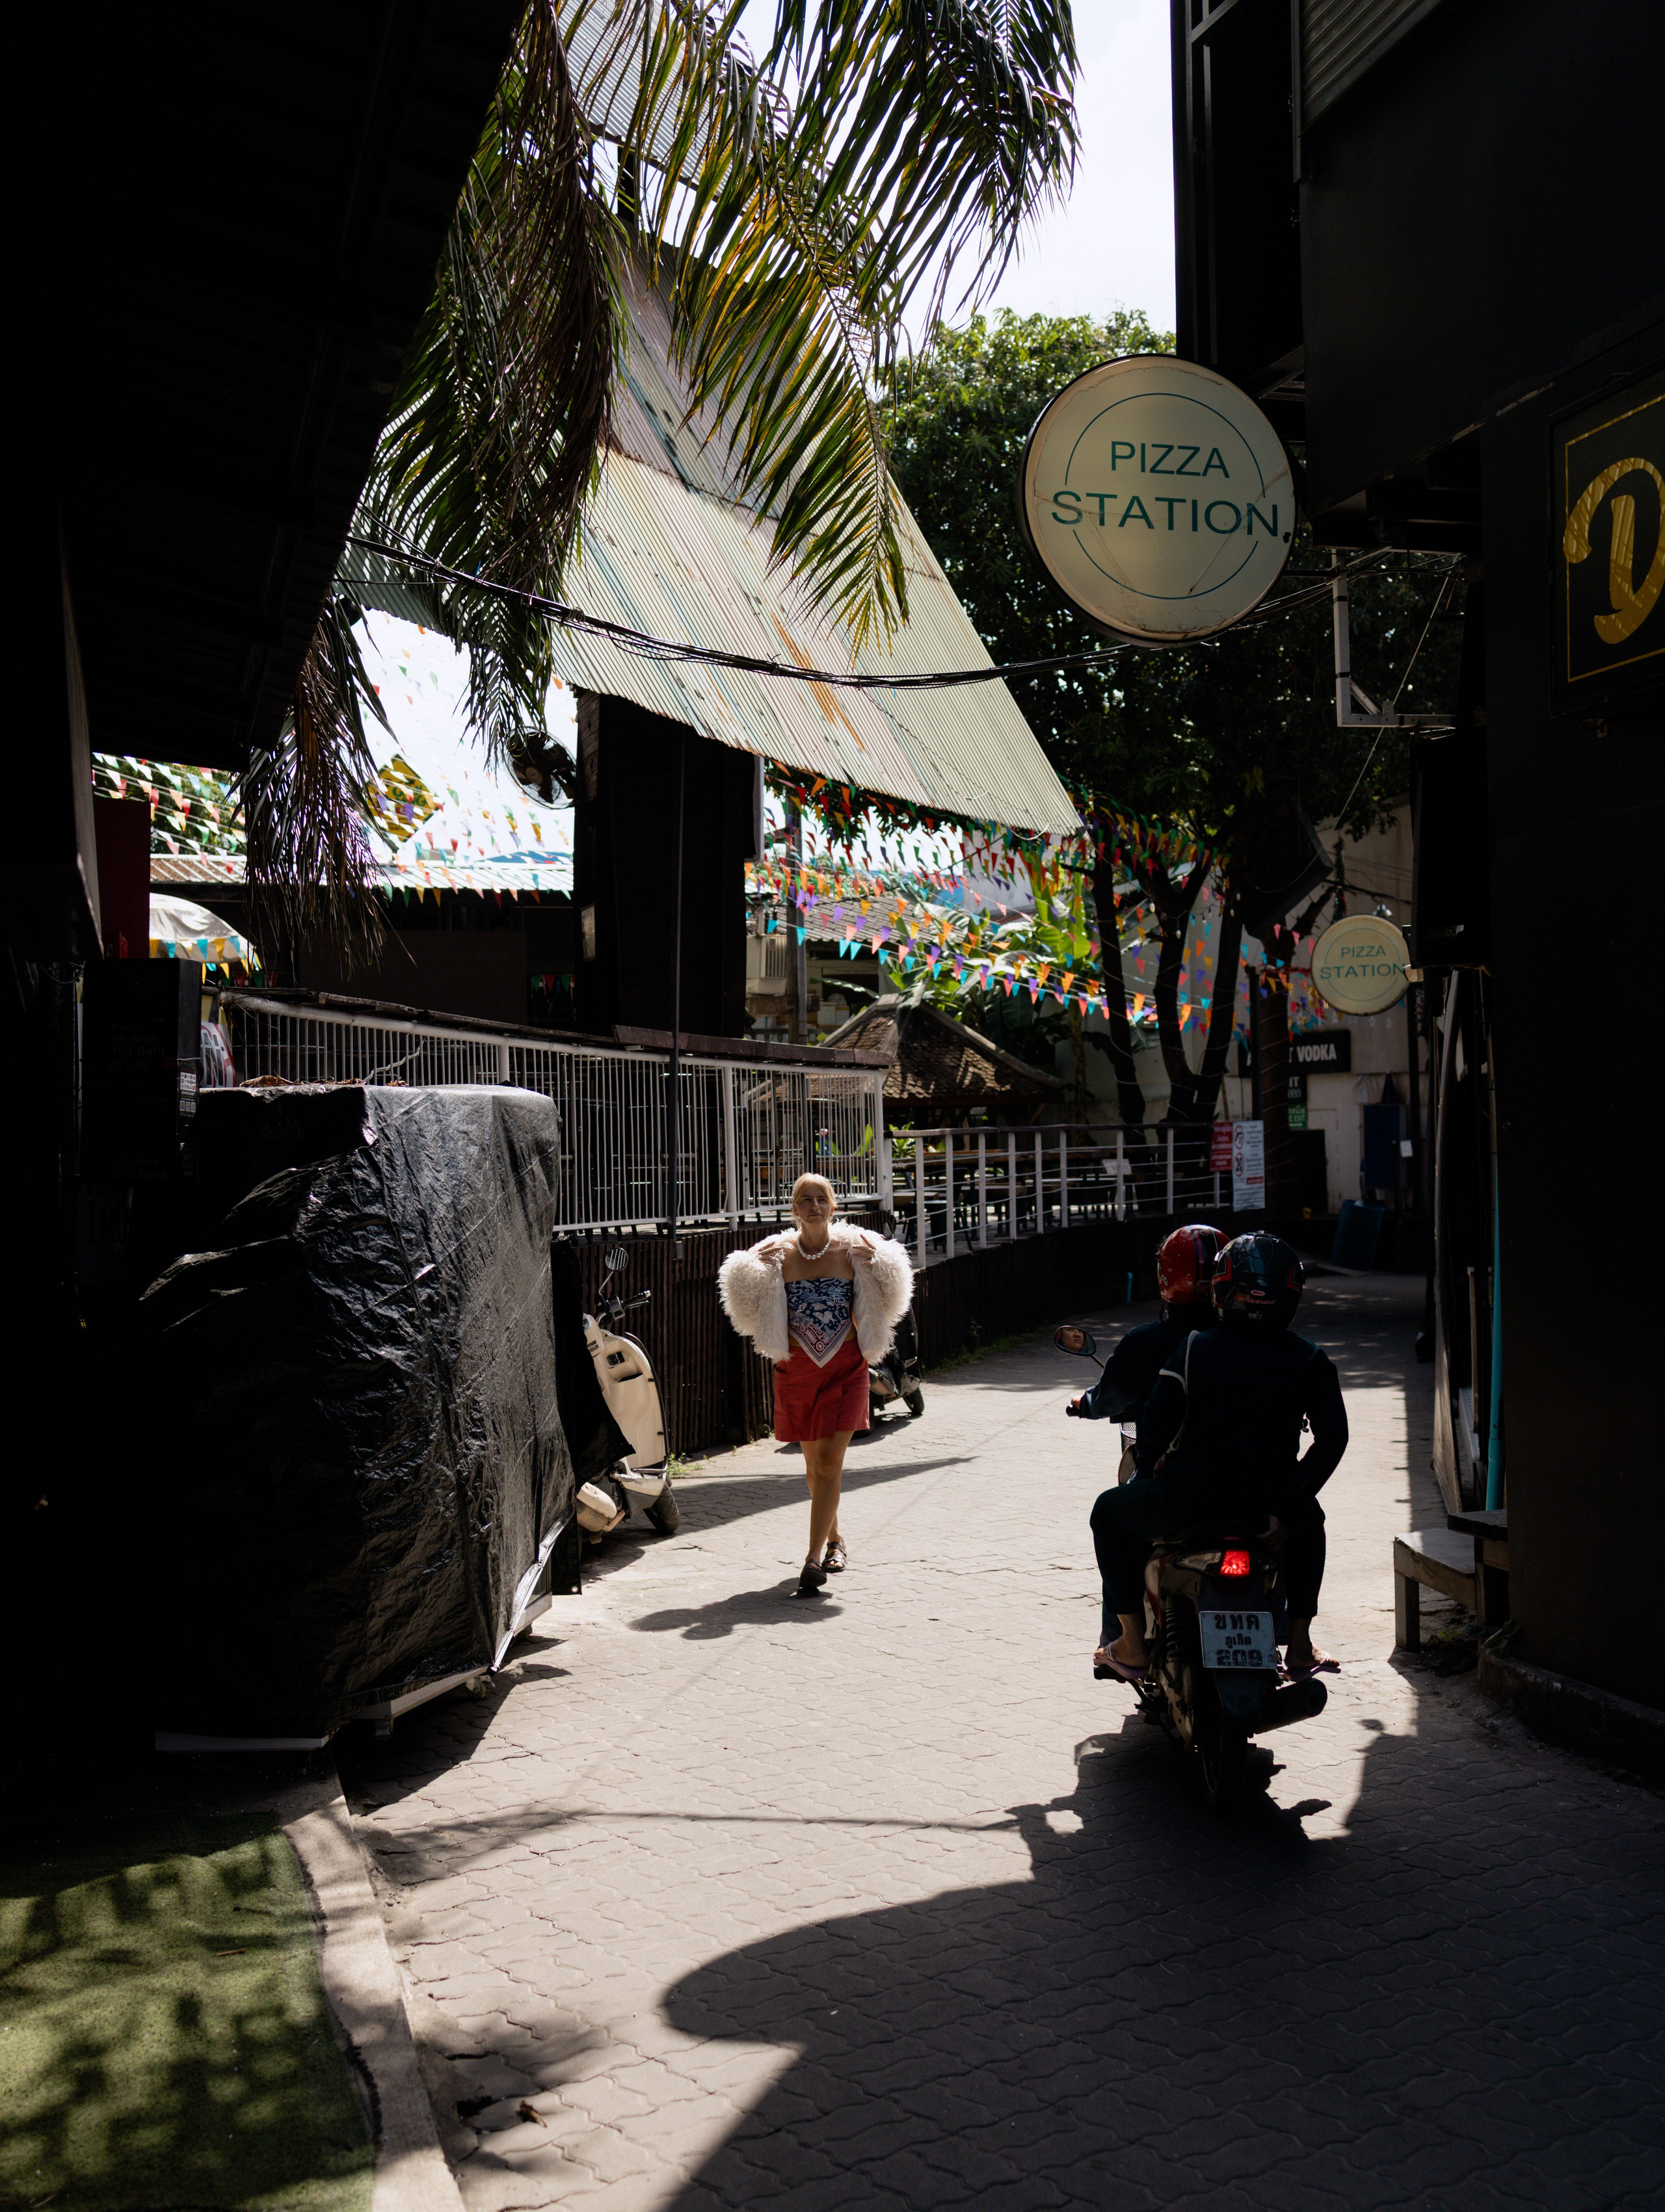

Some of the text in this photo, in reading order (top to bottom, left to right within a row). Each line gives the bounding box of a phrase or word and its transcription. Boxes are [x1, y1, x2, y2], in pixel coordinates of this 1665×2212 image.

[1111, 441, 1231, 478] PIZZA
[1052, 490, 1279, 537] STATION
[1341, 945, 1387, 958] PIZZA
[1320, 963, 1405, 979] STATION
[111, 1022, 143, 1032] Pistol
[112, 1034, 157, 1044] 15 Shot
[112, 1046, 165, 1056] 100 Baht
[1296, 1043, 1337, 1063] VODKA
[113, 1158, 159, 1167] 50 Shot
[113, 1169, 166, 1179] 200 Baht
[1216, 1649, 1263, 1667] 209
